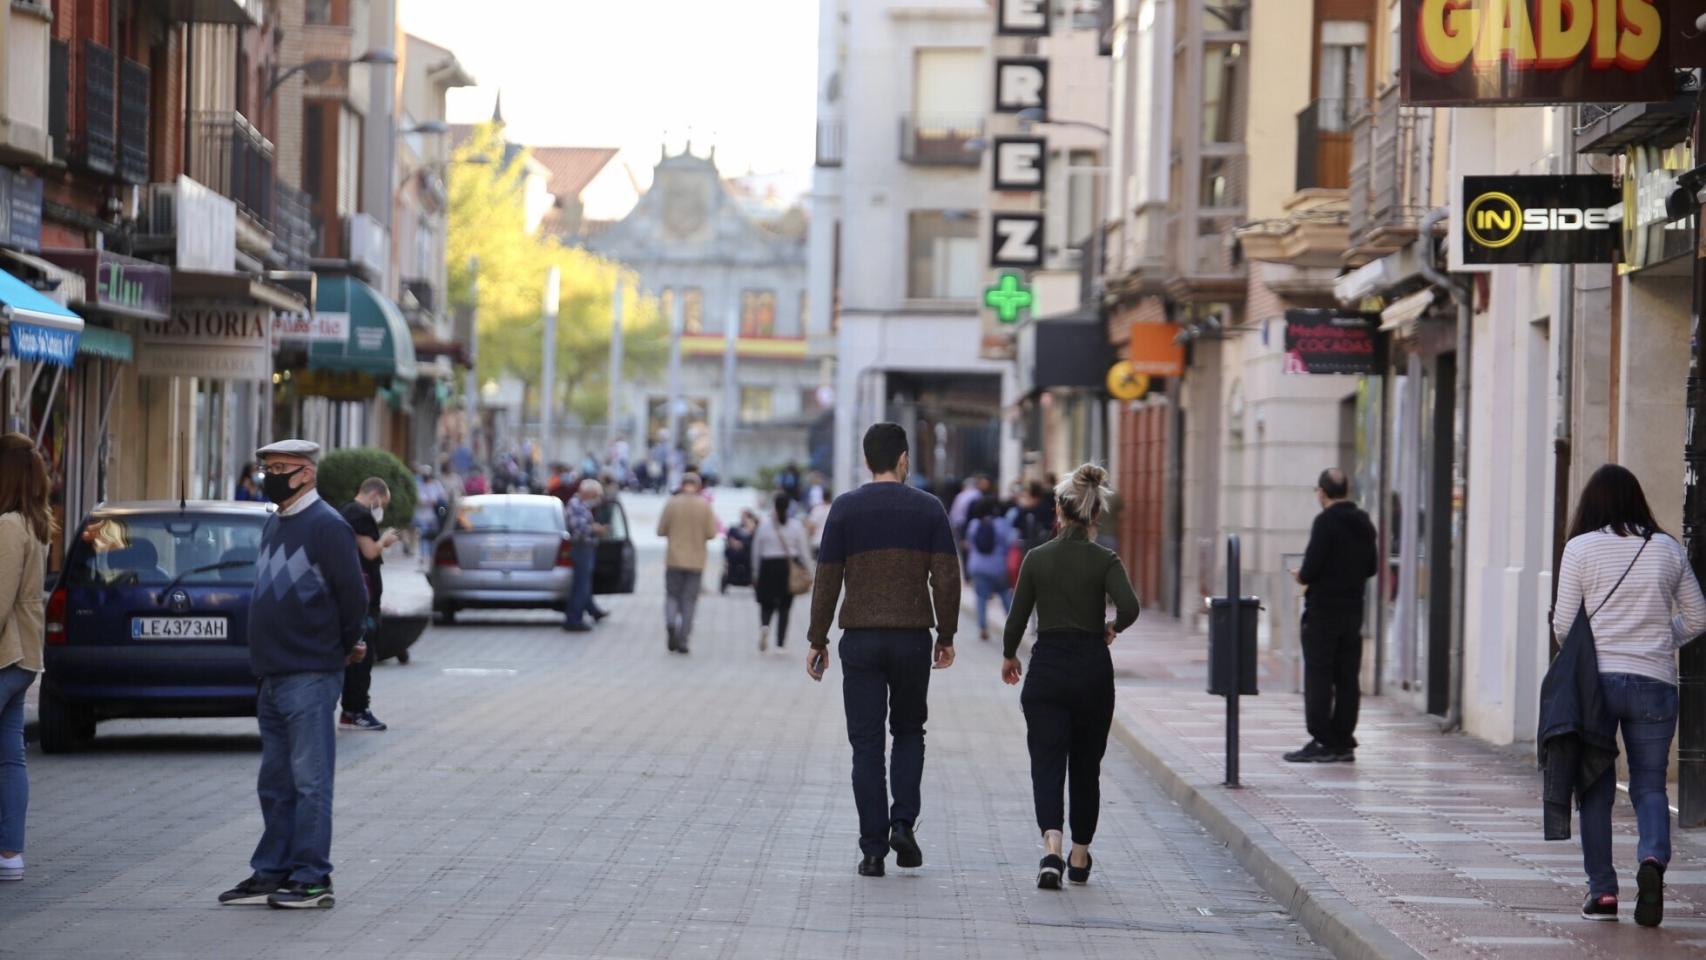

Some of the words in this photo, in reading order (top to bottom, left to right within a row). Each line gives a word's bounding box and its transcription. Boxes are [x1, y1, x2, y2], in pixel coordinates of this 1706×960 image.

[1416, 0, 1662, 74] GADIS
[144, 308, 264, 337] GESTORIA
[1296, 339, 1374, 354] COCADAS
